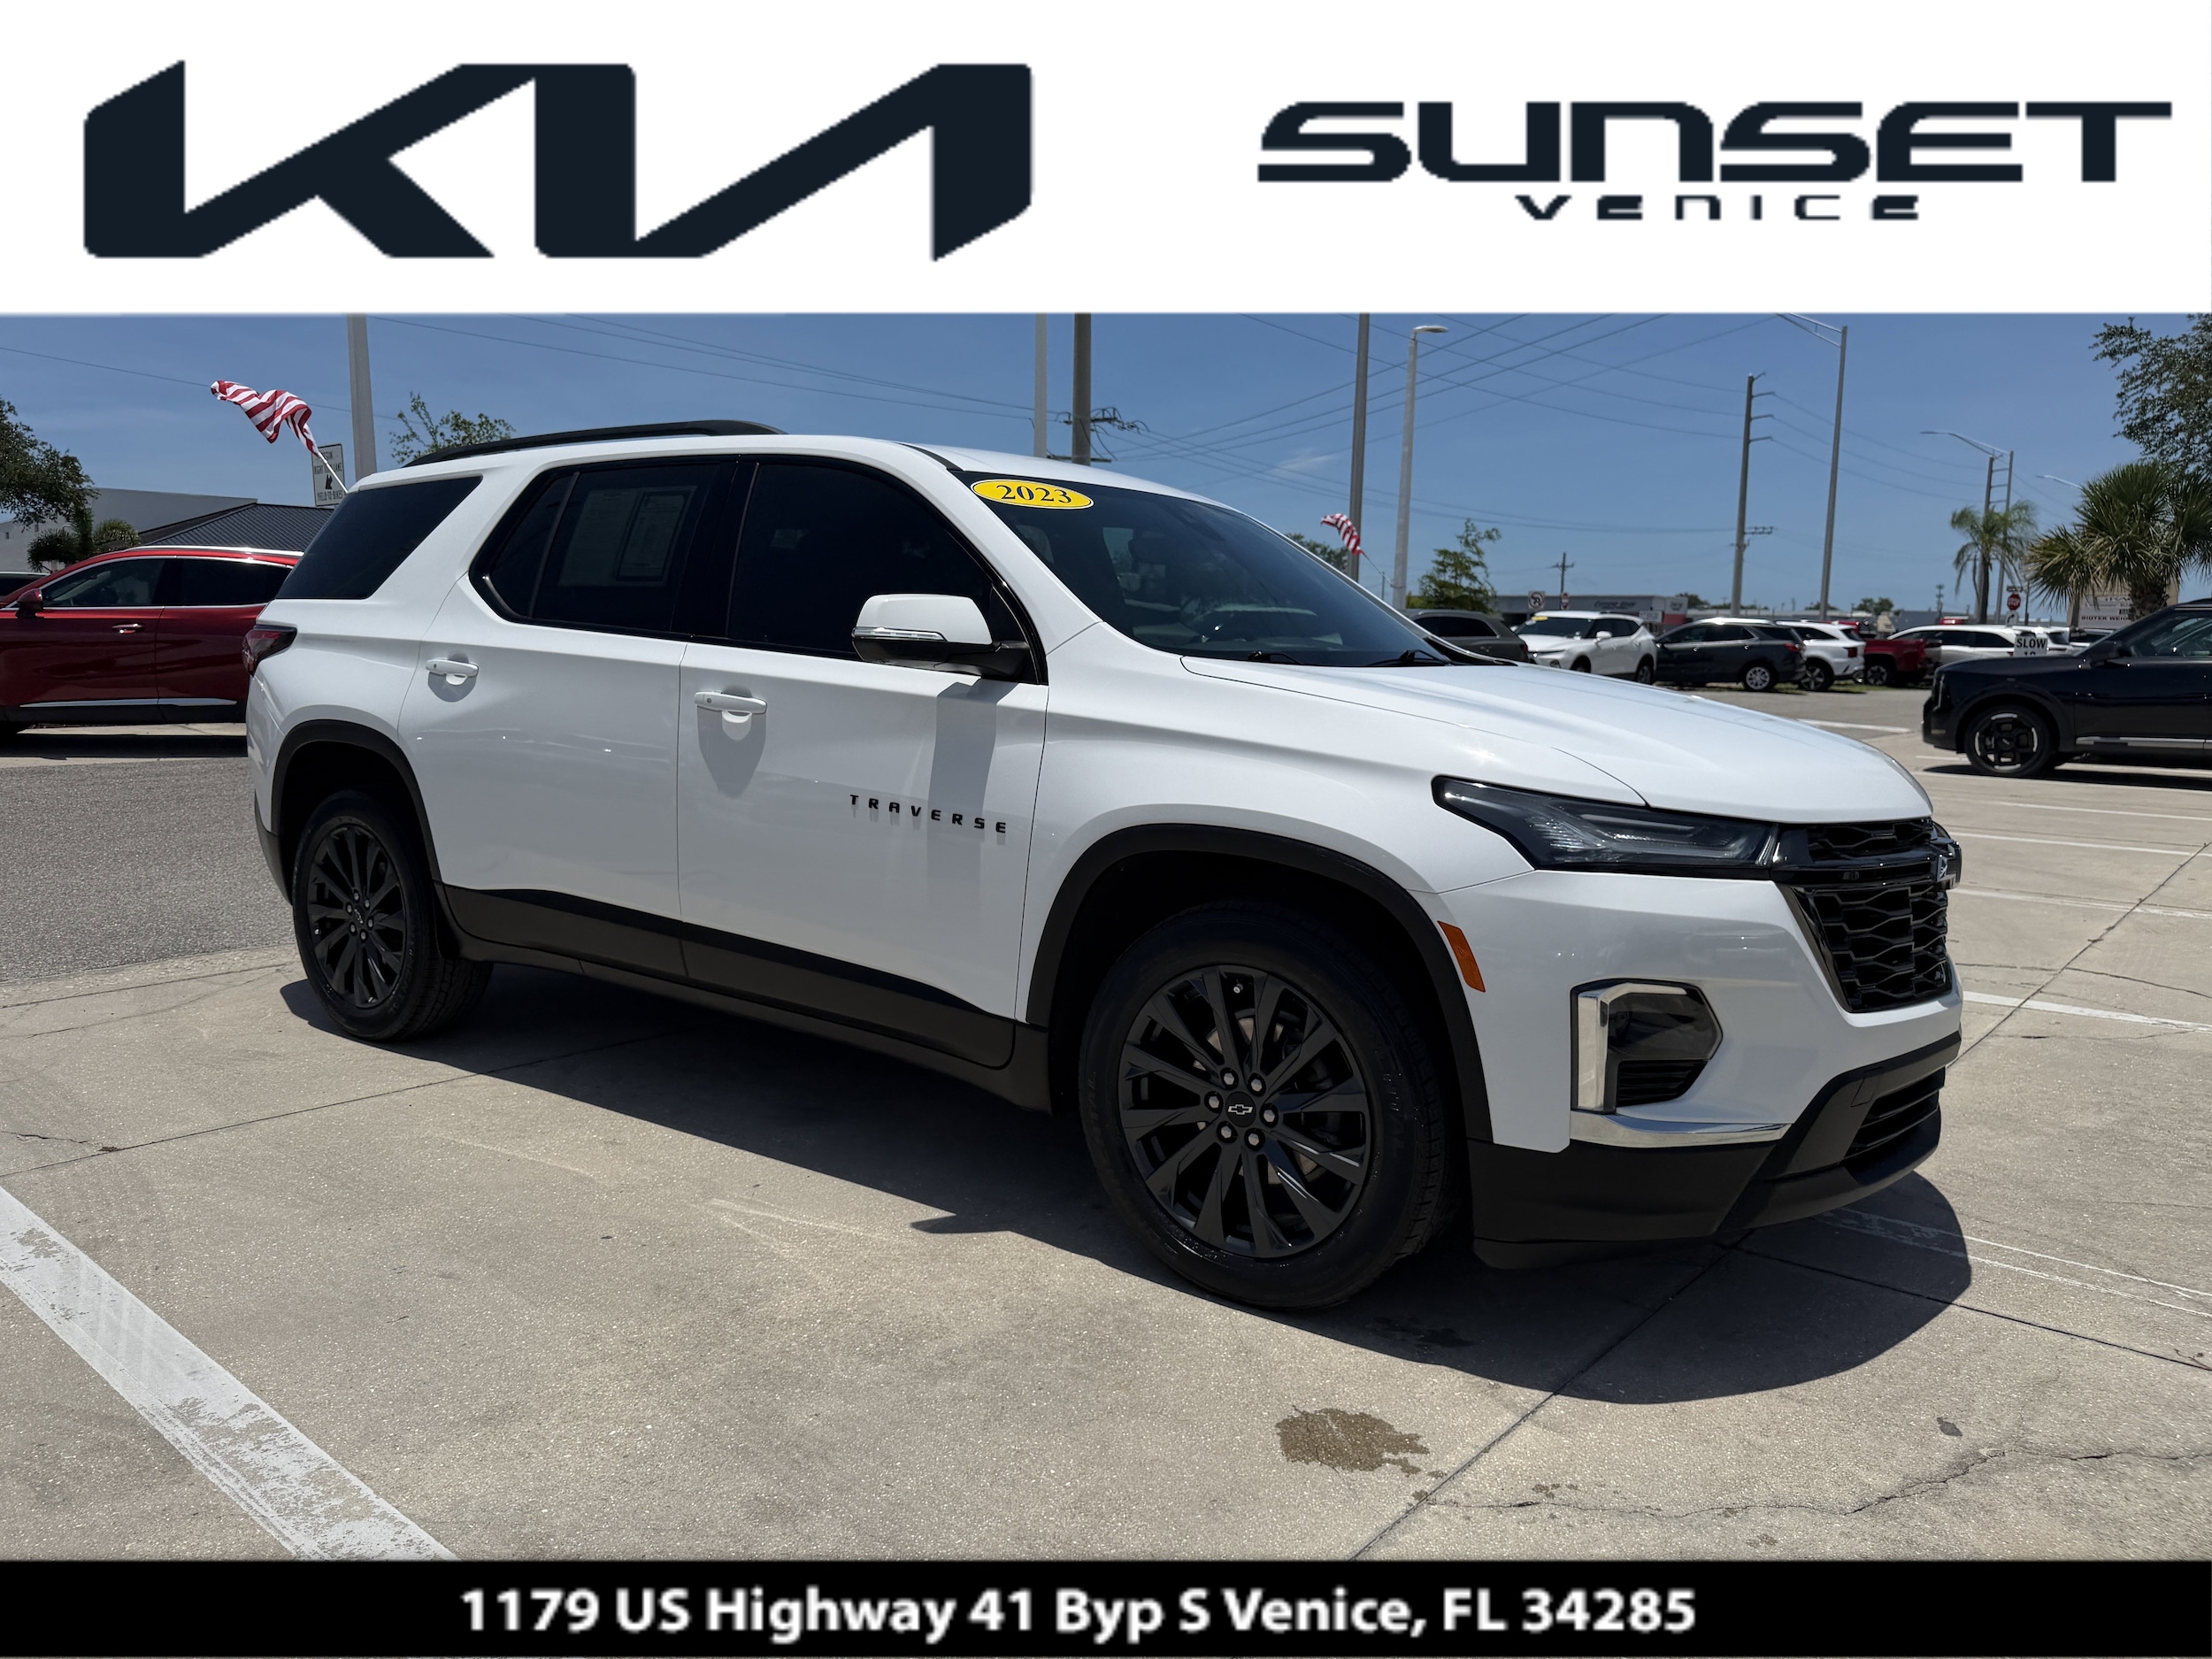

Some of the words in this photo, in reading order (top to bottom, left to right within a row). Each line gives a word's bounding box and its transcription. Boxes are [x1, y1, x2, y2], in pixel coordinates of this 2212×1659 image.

[996, 484, 1071, 503] 2023
[2007, 597, 2021, 607] STOP
[2016, 638, 2047, 649] SLOW
[849, 794, 1007, 833] TRAVERSE
